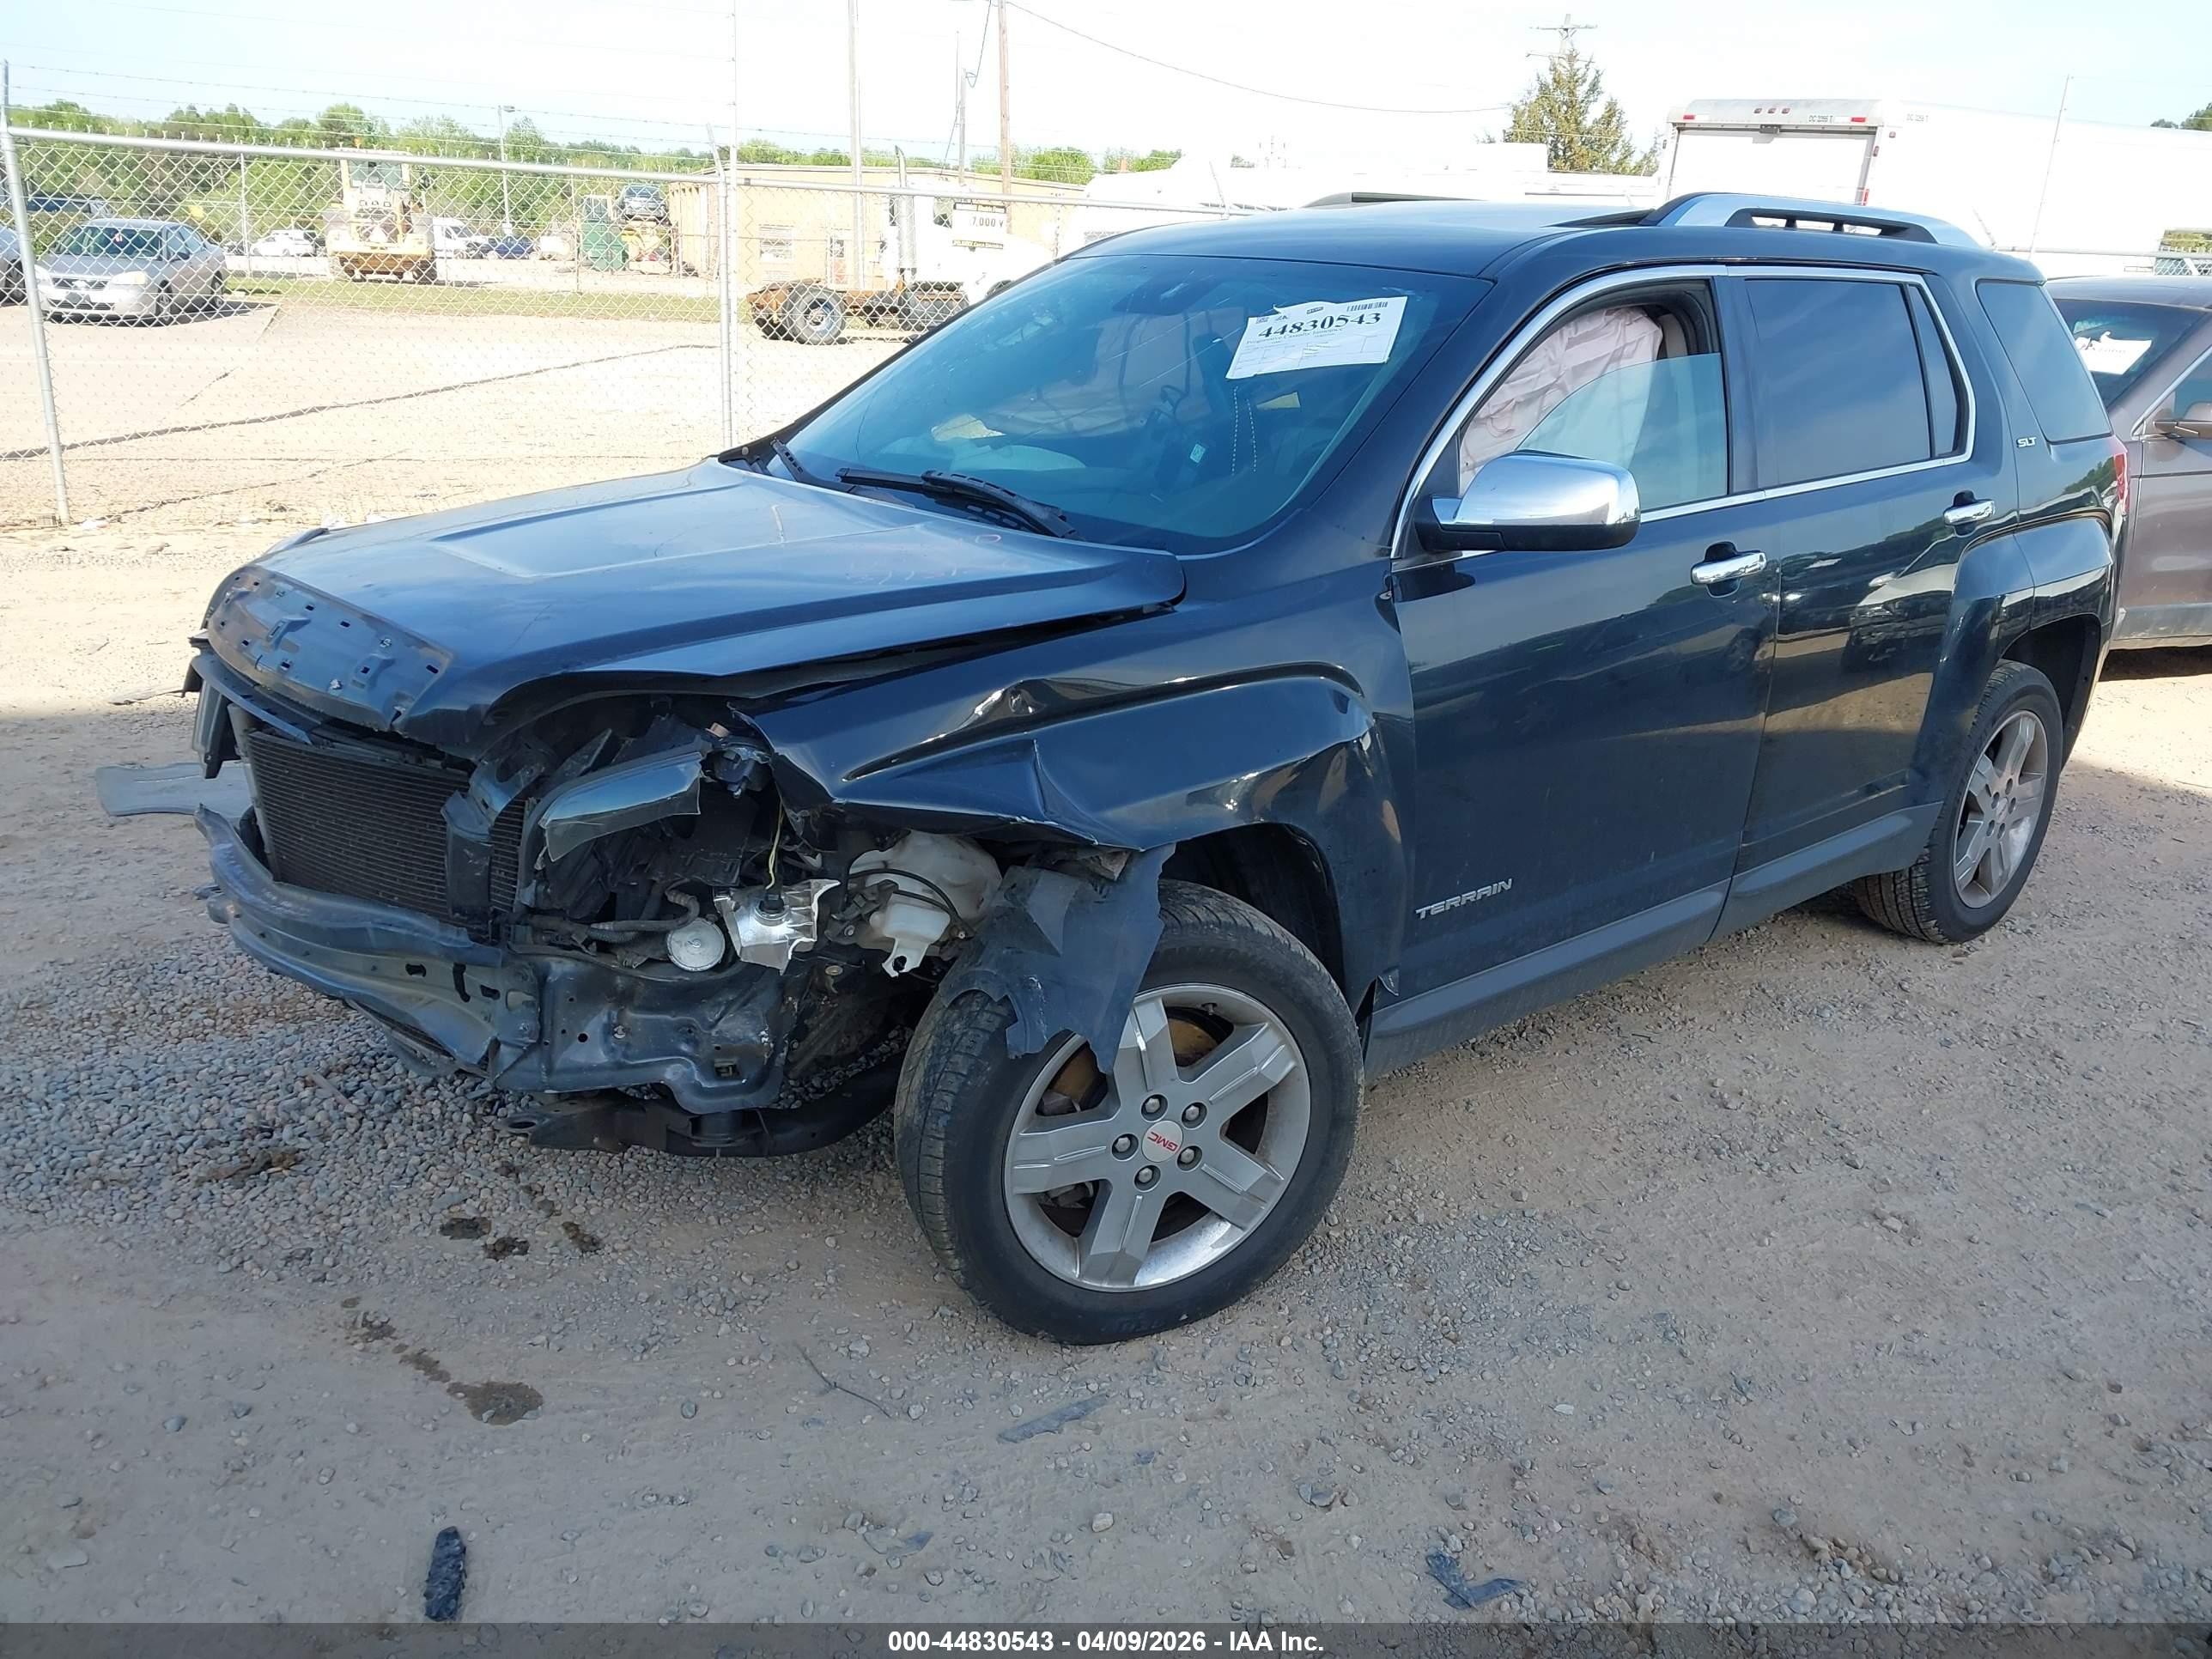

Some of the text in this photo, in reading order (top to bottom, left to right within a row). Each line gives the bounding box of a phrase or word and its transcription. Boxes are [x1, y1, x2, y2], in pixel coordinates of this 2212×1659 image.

[1258, 312, 1381, 338] 44830543
[1415, 878, 1512, 920] TERRAIN
[1147, 1131, 1178, 1152] GMC
